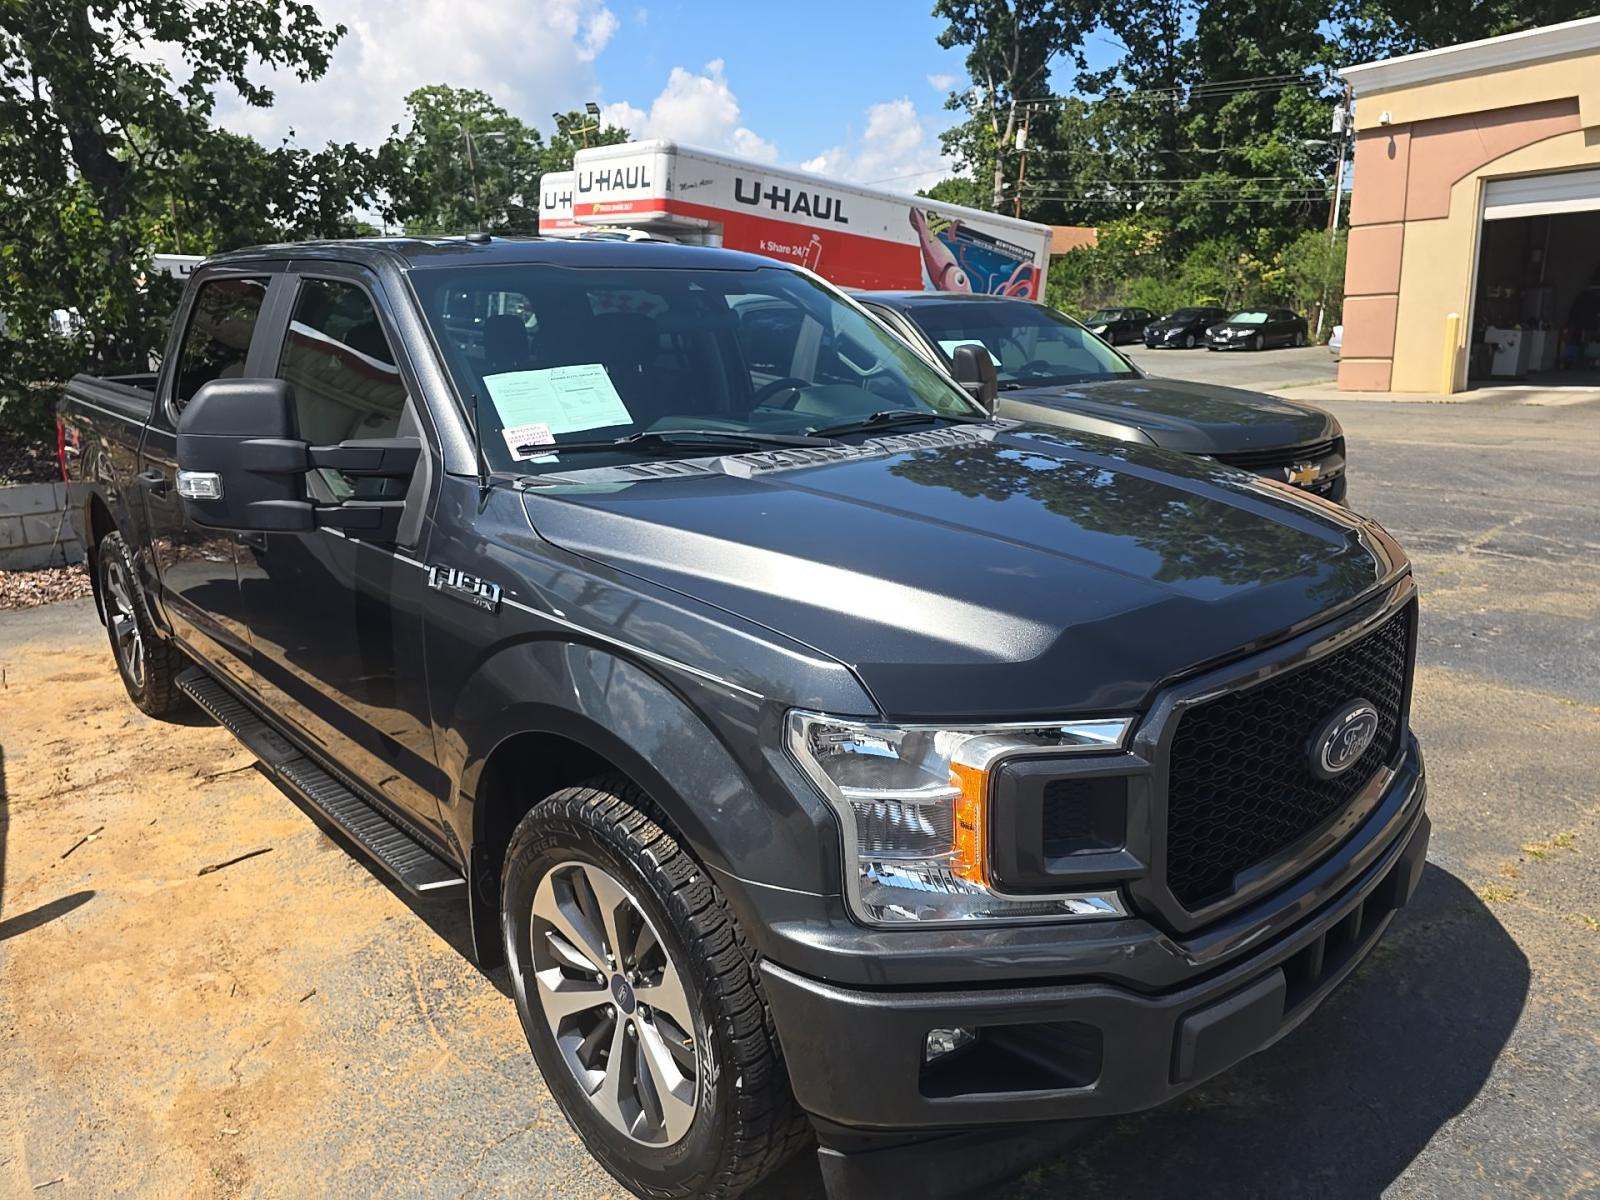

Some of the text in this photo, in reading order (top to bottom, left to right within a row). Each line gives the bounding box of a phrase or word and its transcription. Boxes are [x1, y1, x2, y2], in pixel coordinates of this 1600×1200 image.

[578, 165, 651, 193] U-HAUL
[544, 191, 573, 210] U-H
[734, 177, 849, 225] U-HAUL
[767, 241, 791, 254] Share
[792, 245, 810, 257] 24/7
[1338, 720, 1372, 762] Ford
